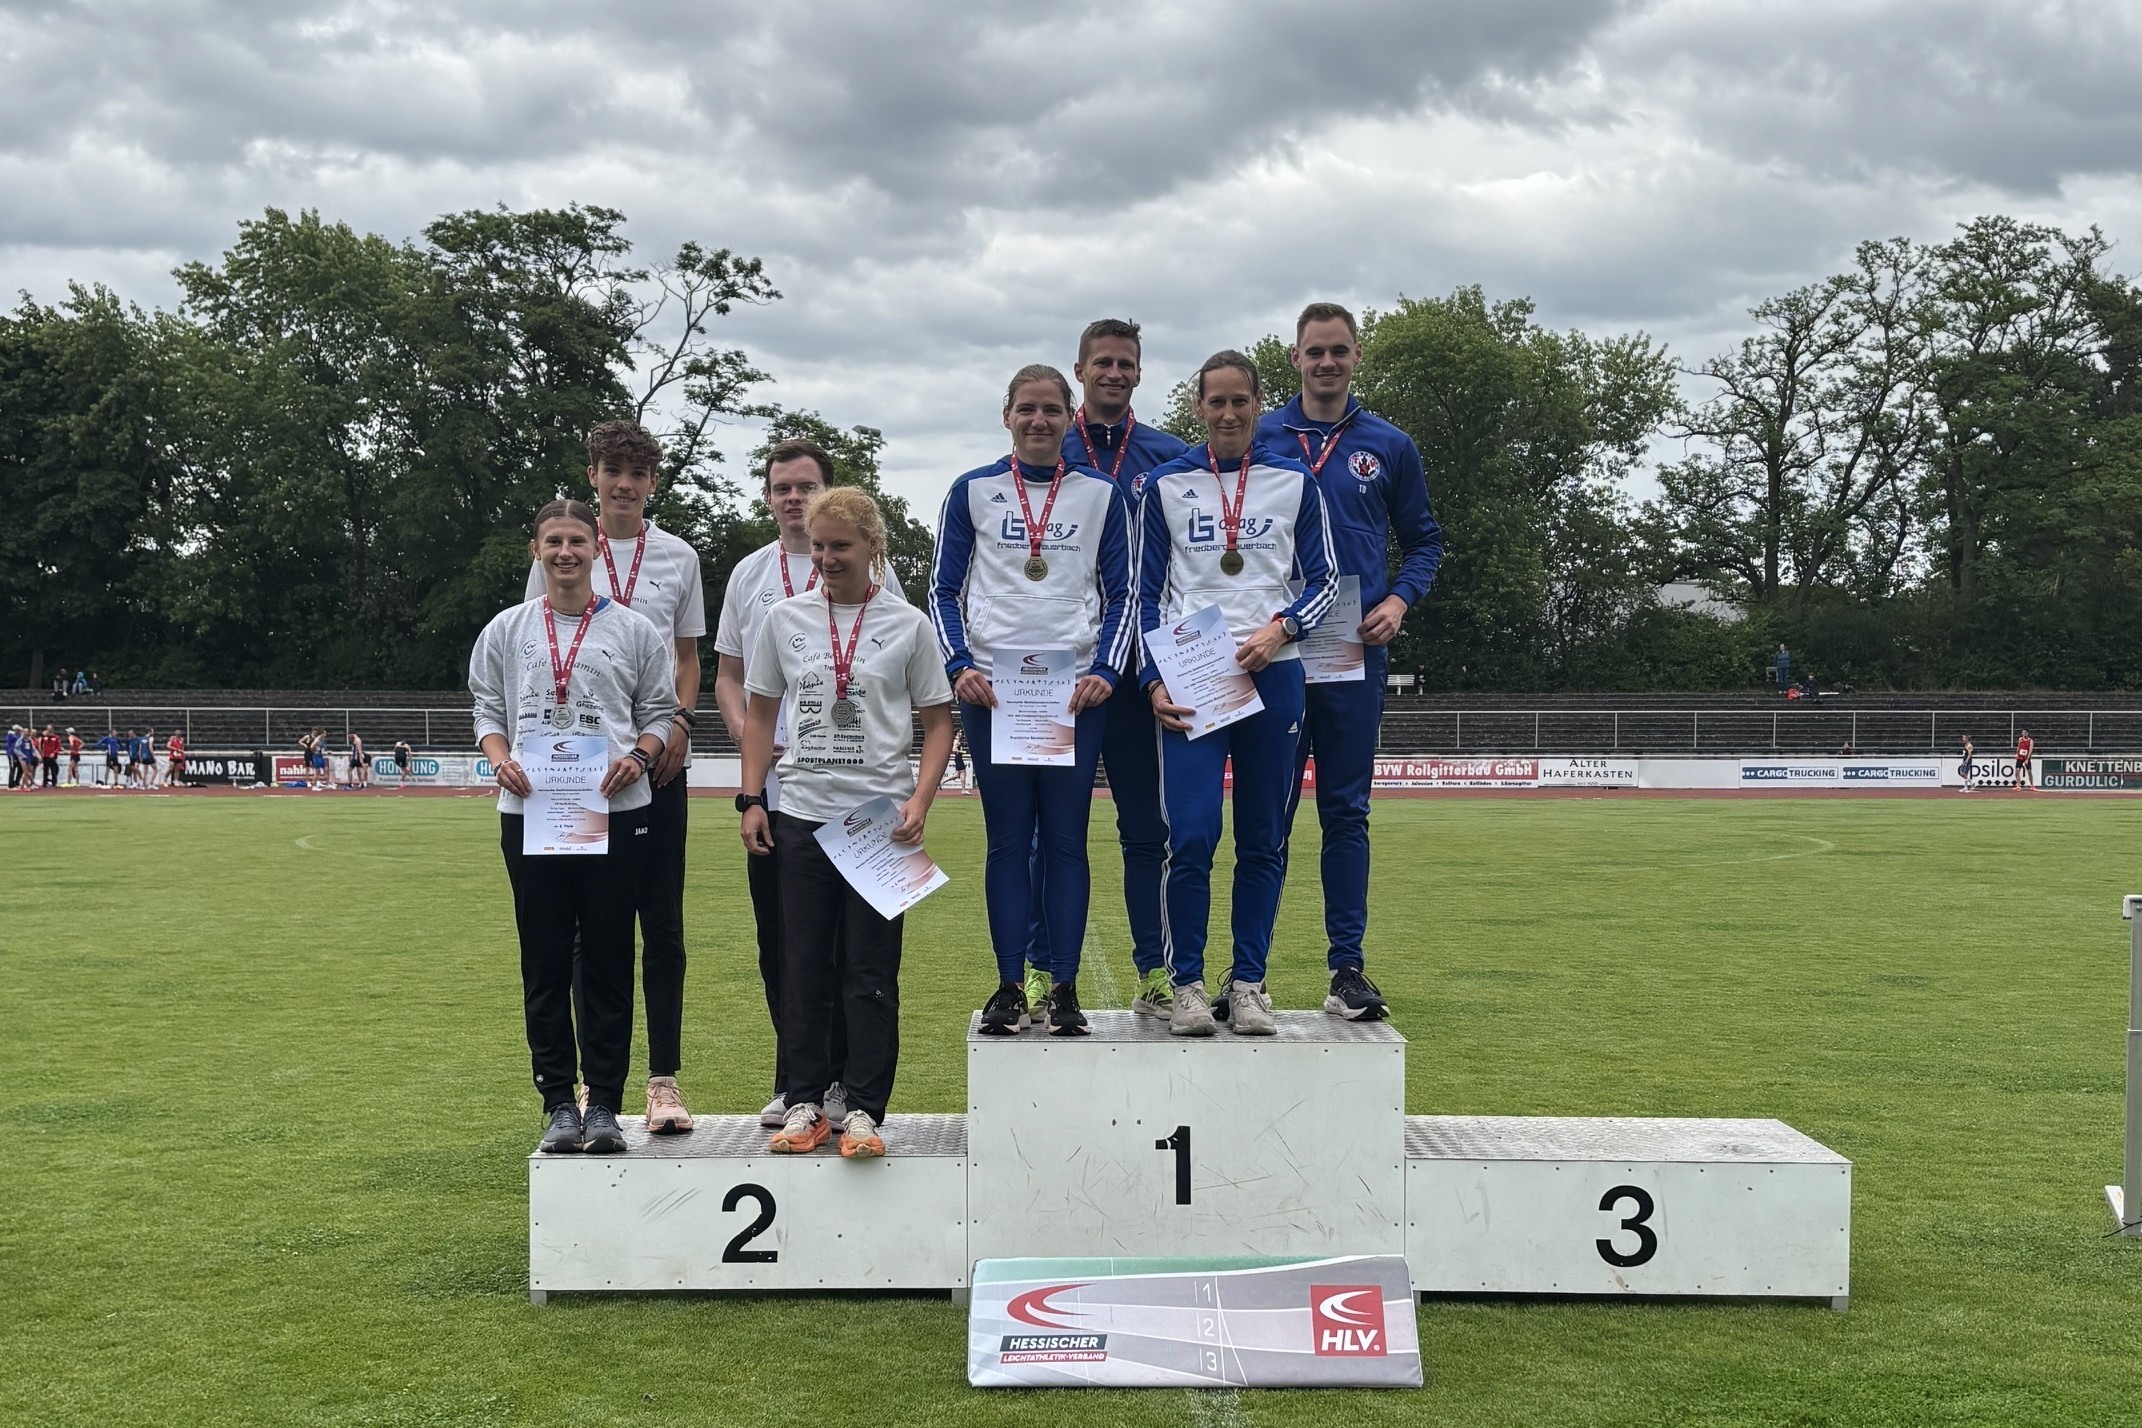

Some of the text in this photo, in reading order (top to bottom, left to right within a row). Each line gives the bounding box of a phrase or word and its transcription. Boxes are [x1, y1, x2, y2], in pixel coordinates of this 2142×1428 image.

[185, 760, 256, 775] MANO BAR
[379, 761, 436, 774] HOUNG
[1569, 759, 1607, 767] ALTER
[1374, 763, 1533, 779] BVW Rollgitterbau GmbH
[1543, 769, 1633, 778] HAFERKASTEN
[1757, 769, 1835, 778] CARGO TRUCKING
[1858, 769, 1936, 778] CARGO TRUCKING
[2045, 775, 2118, 787] GURDULIC
[1156, 1126, 1192, 1205] 1
[721, 1184, 778, 1262] 2
[1596, 1185, 1657, 1267] 3
[1203, 1283, 1211, 1302] 1
[1203, 1317, 1216, 1337] 2
[1009, 1337, 1098, 1350] HESSISCHER
[1003, 1353, 1105, 1362] LEICHTATHLETIK-VERBAND
[1206, 1351, 1217, 1372] 3
